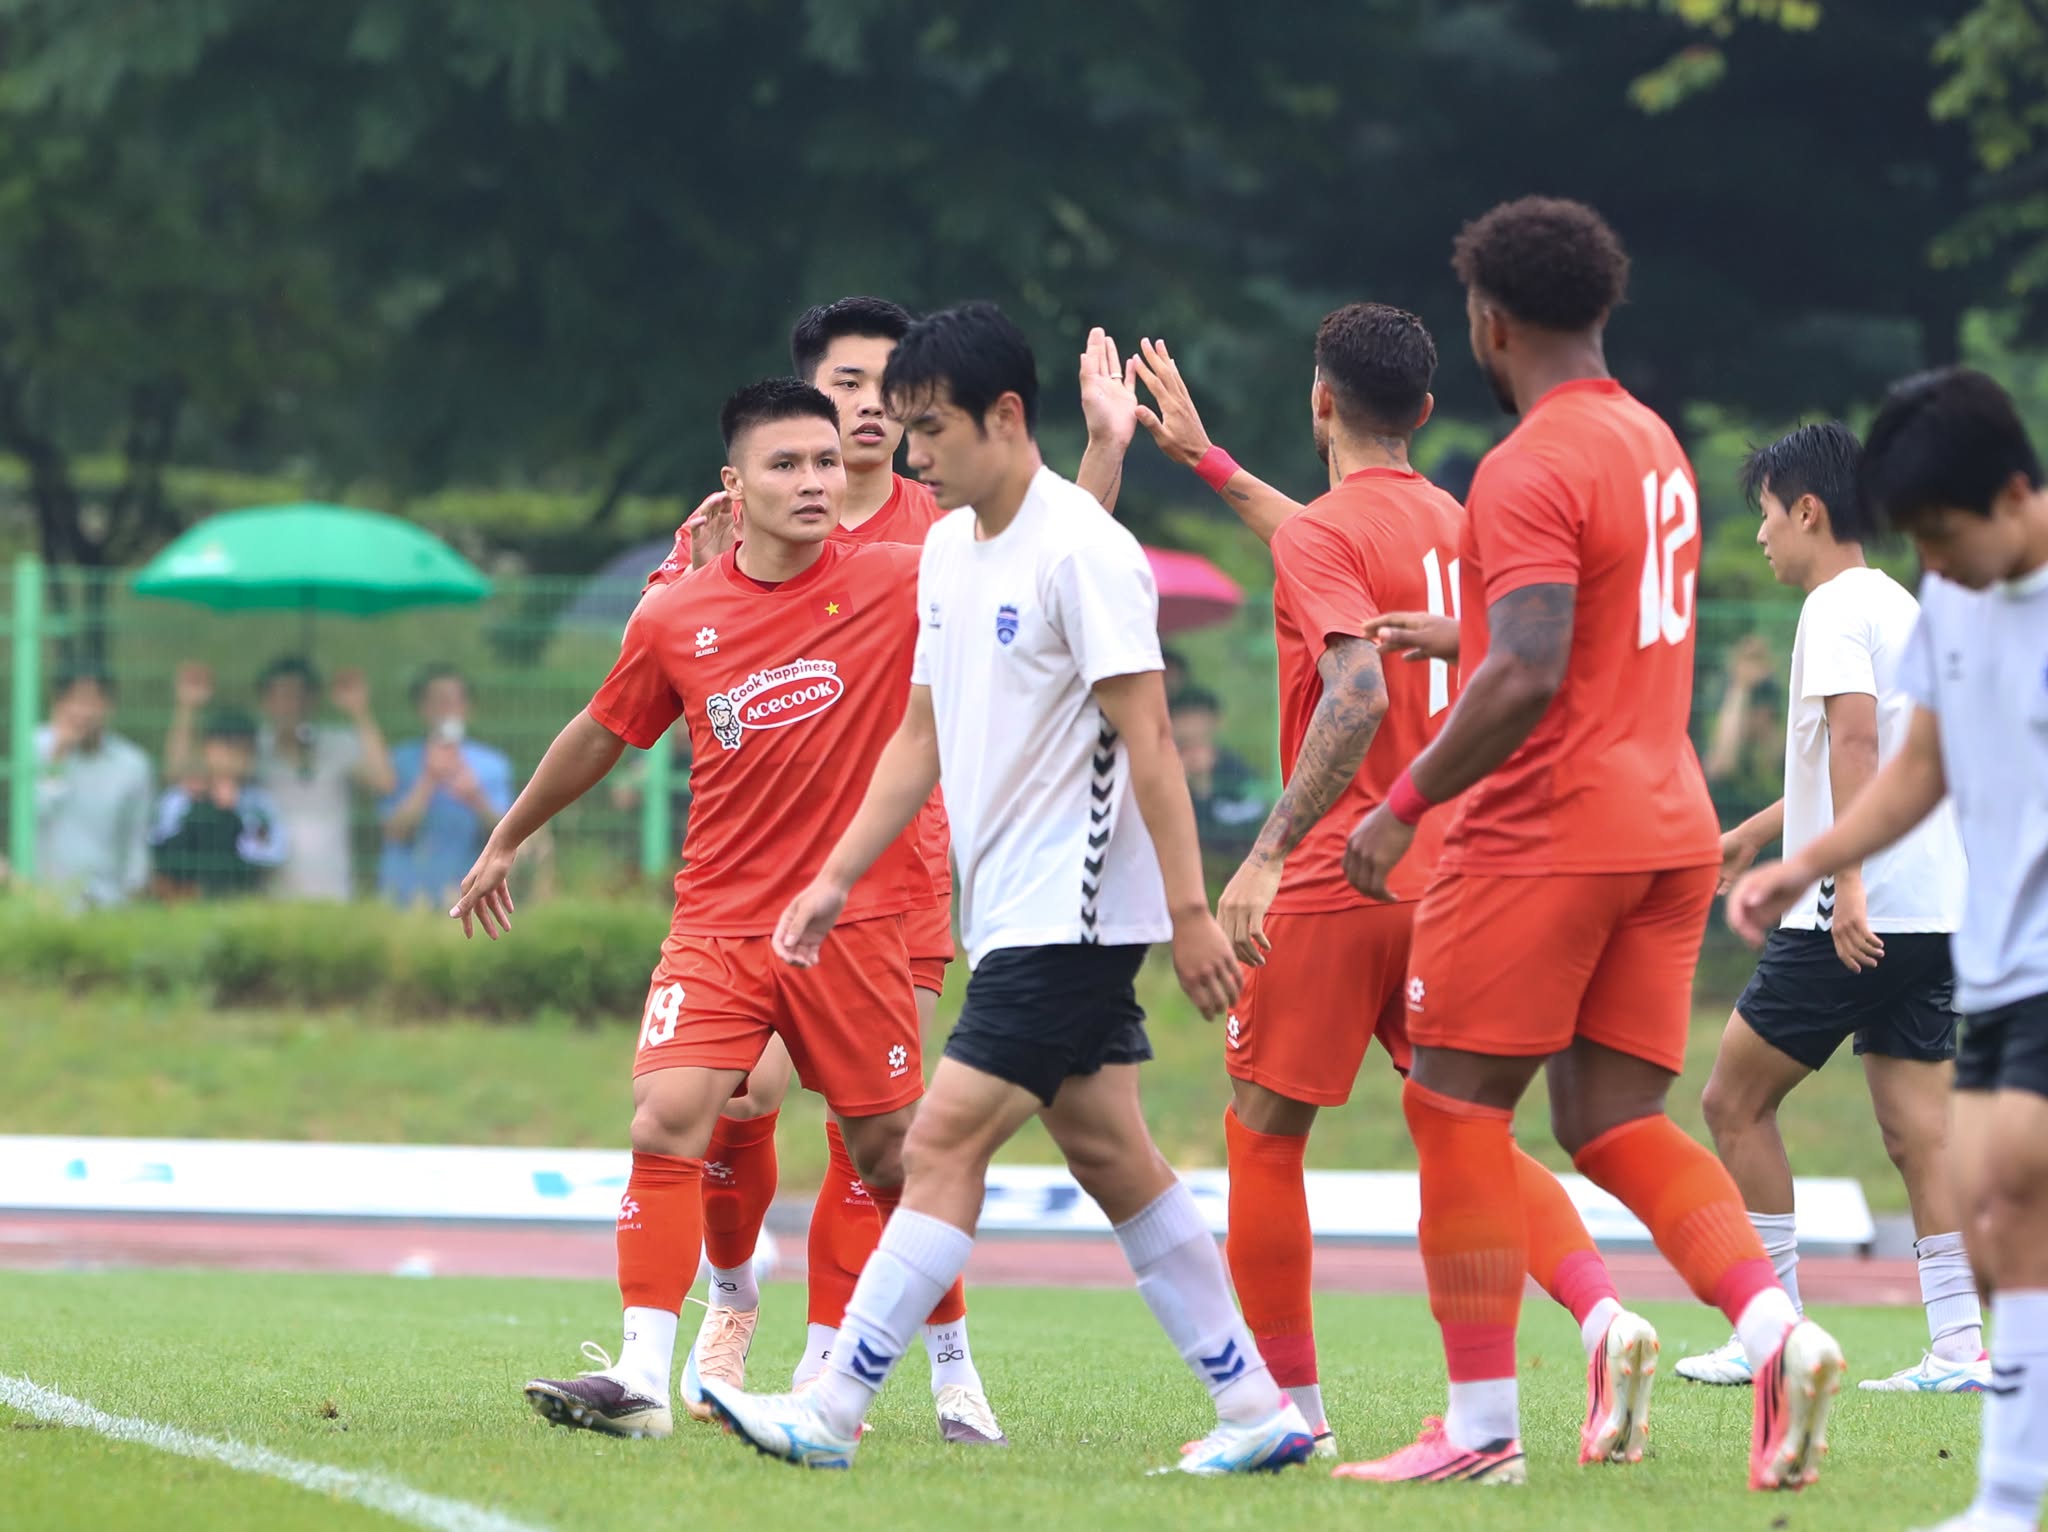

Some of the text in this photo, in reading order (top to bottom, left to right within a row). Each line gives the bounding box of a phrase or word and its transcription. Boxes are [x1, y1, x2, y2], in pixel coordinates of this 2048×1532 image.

[1638, 467, 1698, 650] 12
[731, 661, 834, 702] Cook happiness
[1422, 547, 1461, 718] 1
[639, 982, 686, 1051] 19
